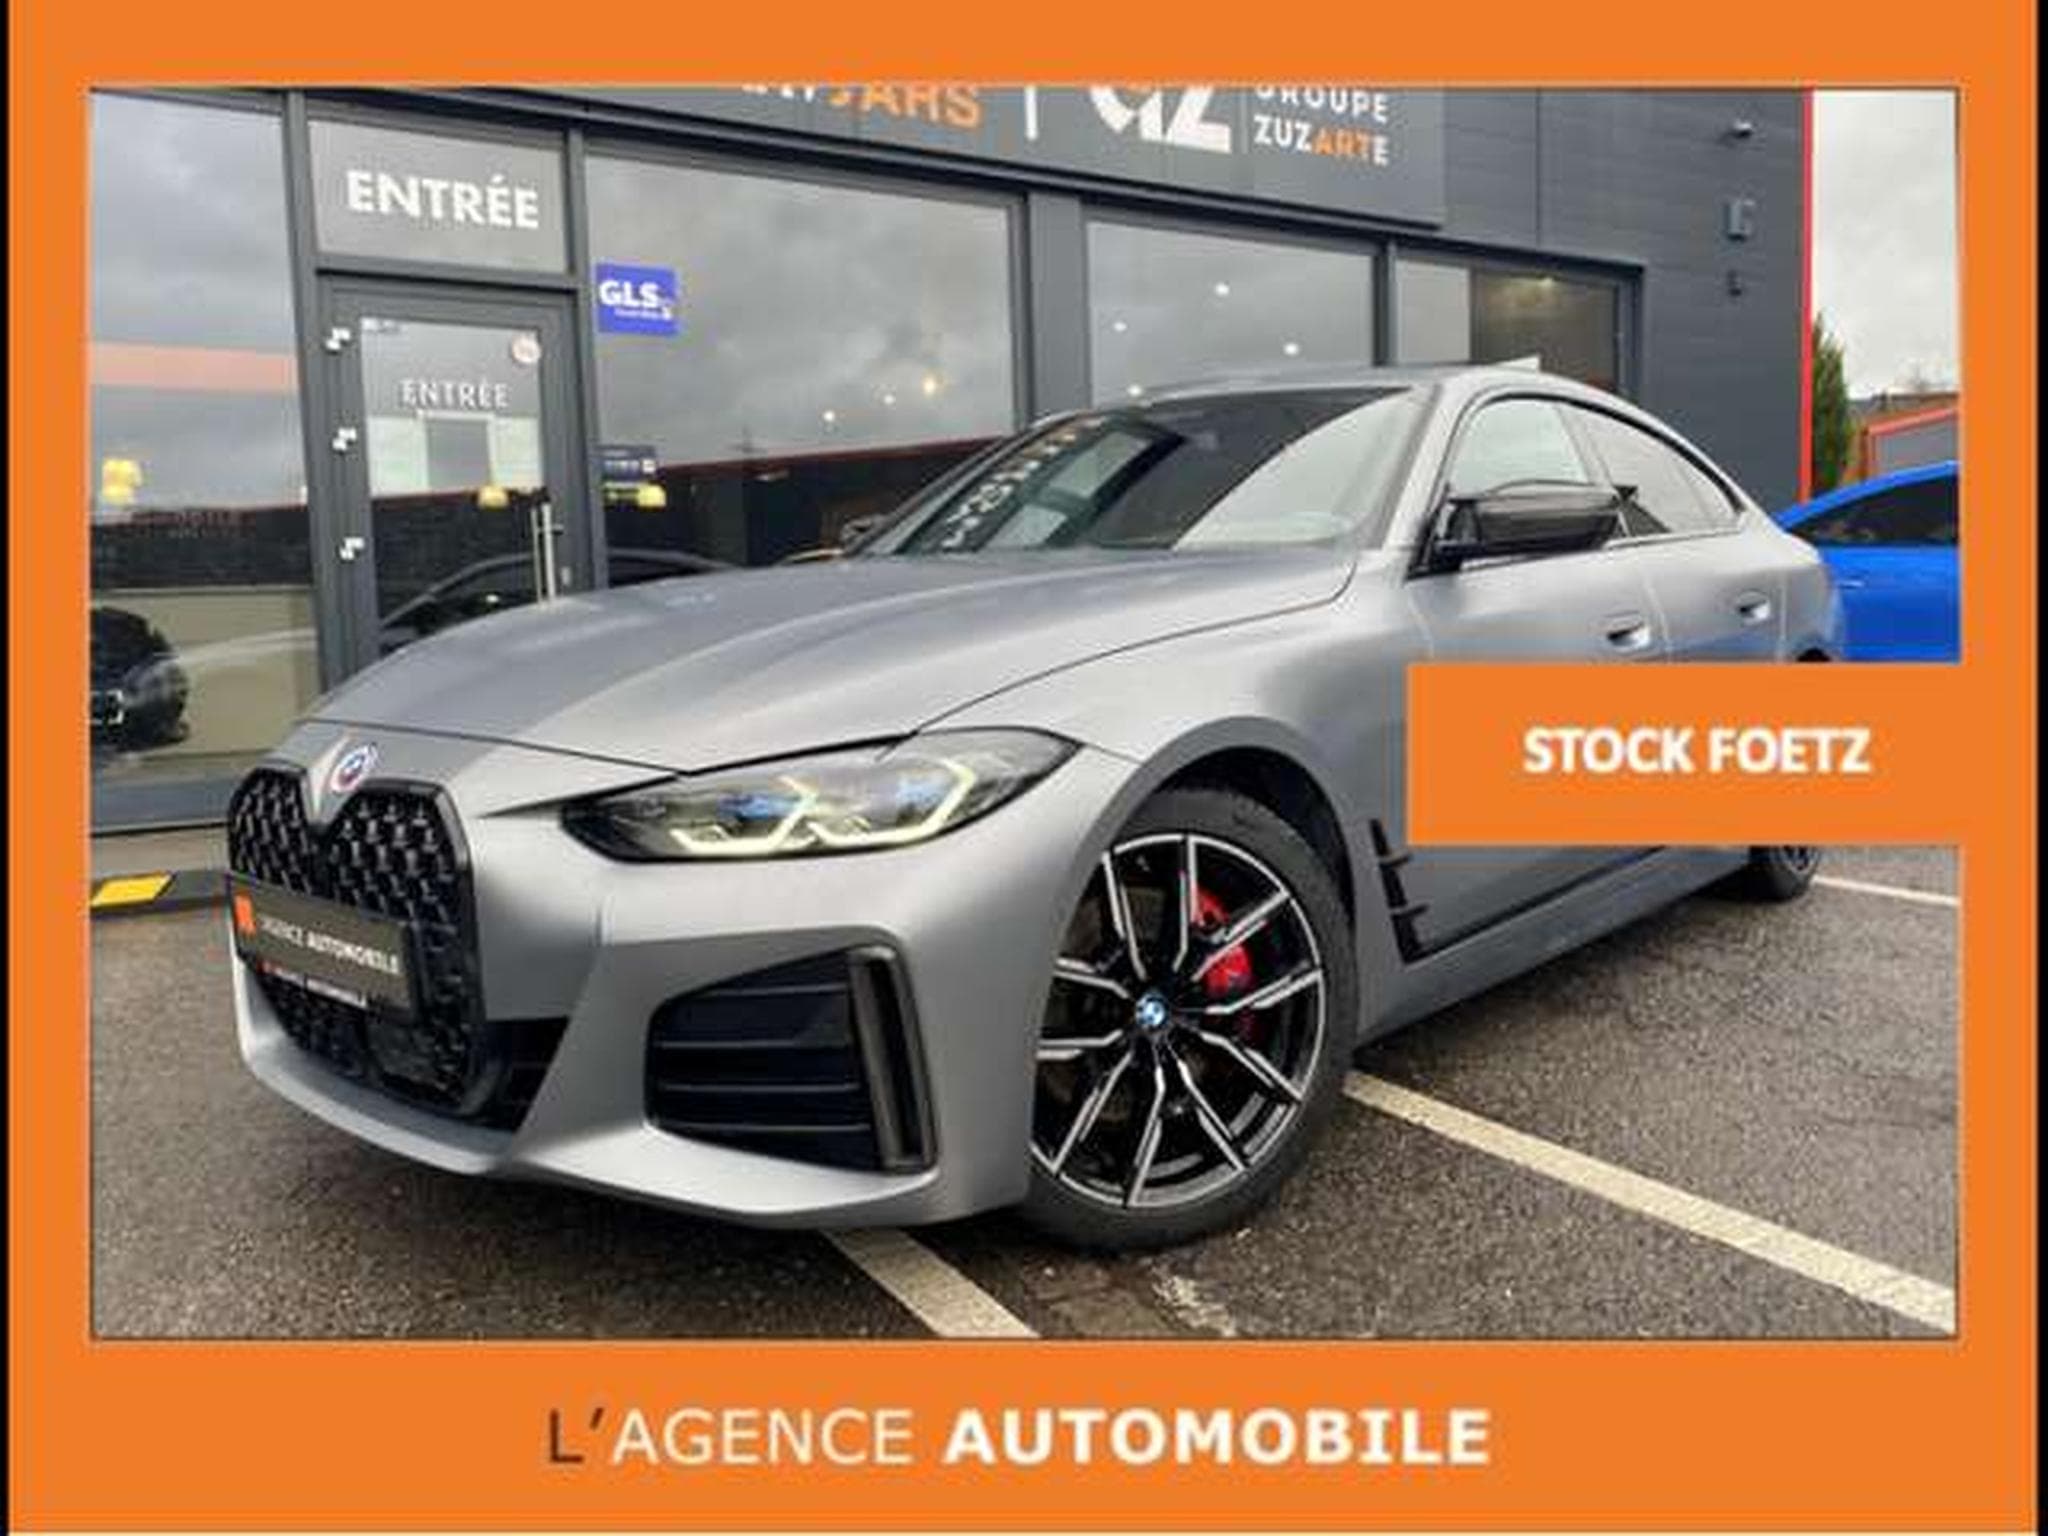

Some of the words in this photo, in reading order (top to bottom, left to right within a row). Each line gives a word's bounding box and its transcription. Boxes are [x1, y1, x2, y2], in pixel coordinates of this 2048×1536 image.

[1253, 114, 1388, 166] ZUZARTE
[347, 170, 539, 229] ENTRÉE
[600, 280, 659, 308] GLS
[401, 374, 508, 410] ENTRÉE
